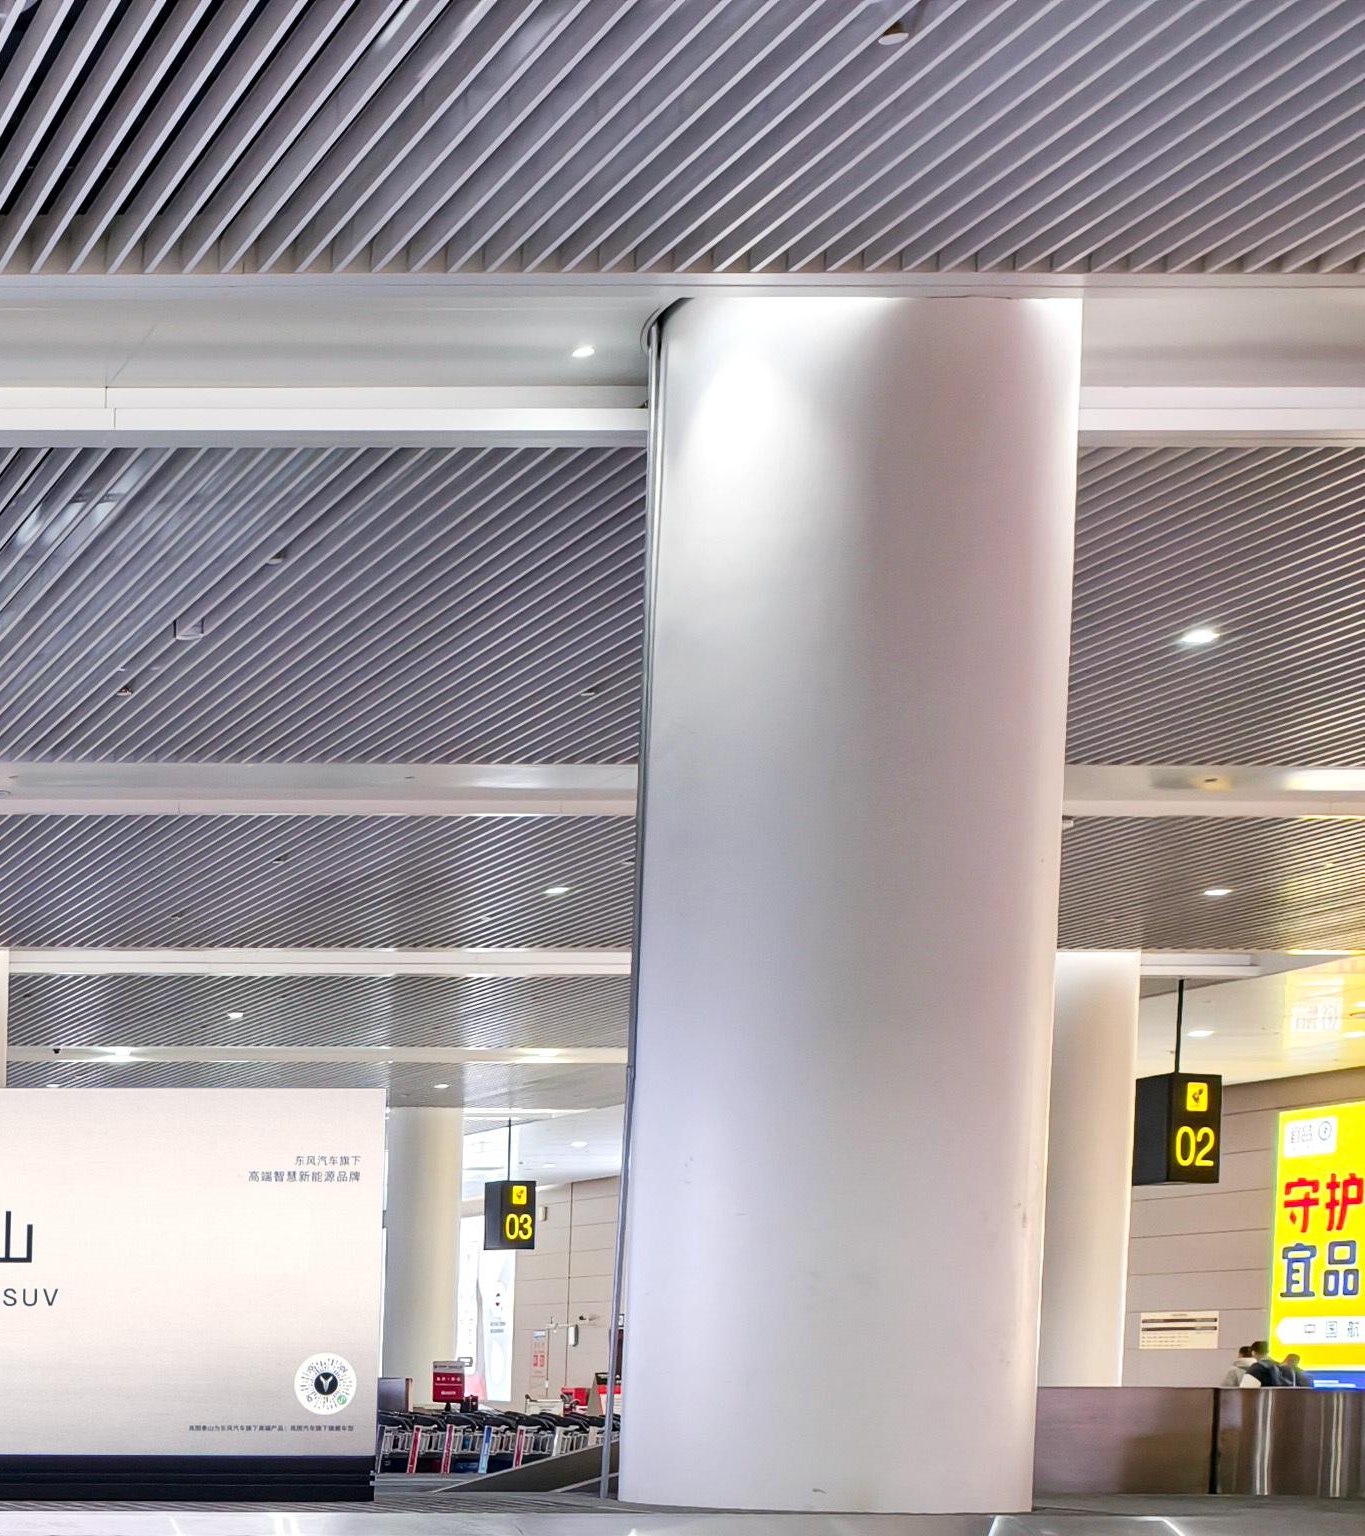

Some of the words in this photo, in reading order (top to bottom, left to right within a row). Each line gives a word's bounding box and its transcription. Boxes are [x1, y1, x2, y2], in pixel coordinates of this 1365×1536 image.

[1175, 1126, 1215, 1167] 02
[505, 1213, 533, 1240] 03
[1284, 1173, 1364, 1233] 守护
[1280, 1240, 1360, 1298] 宜品
